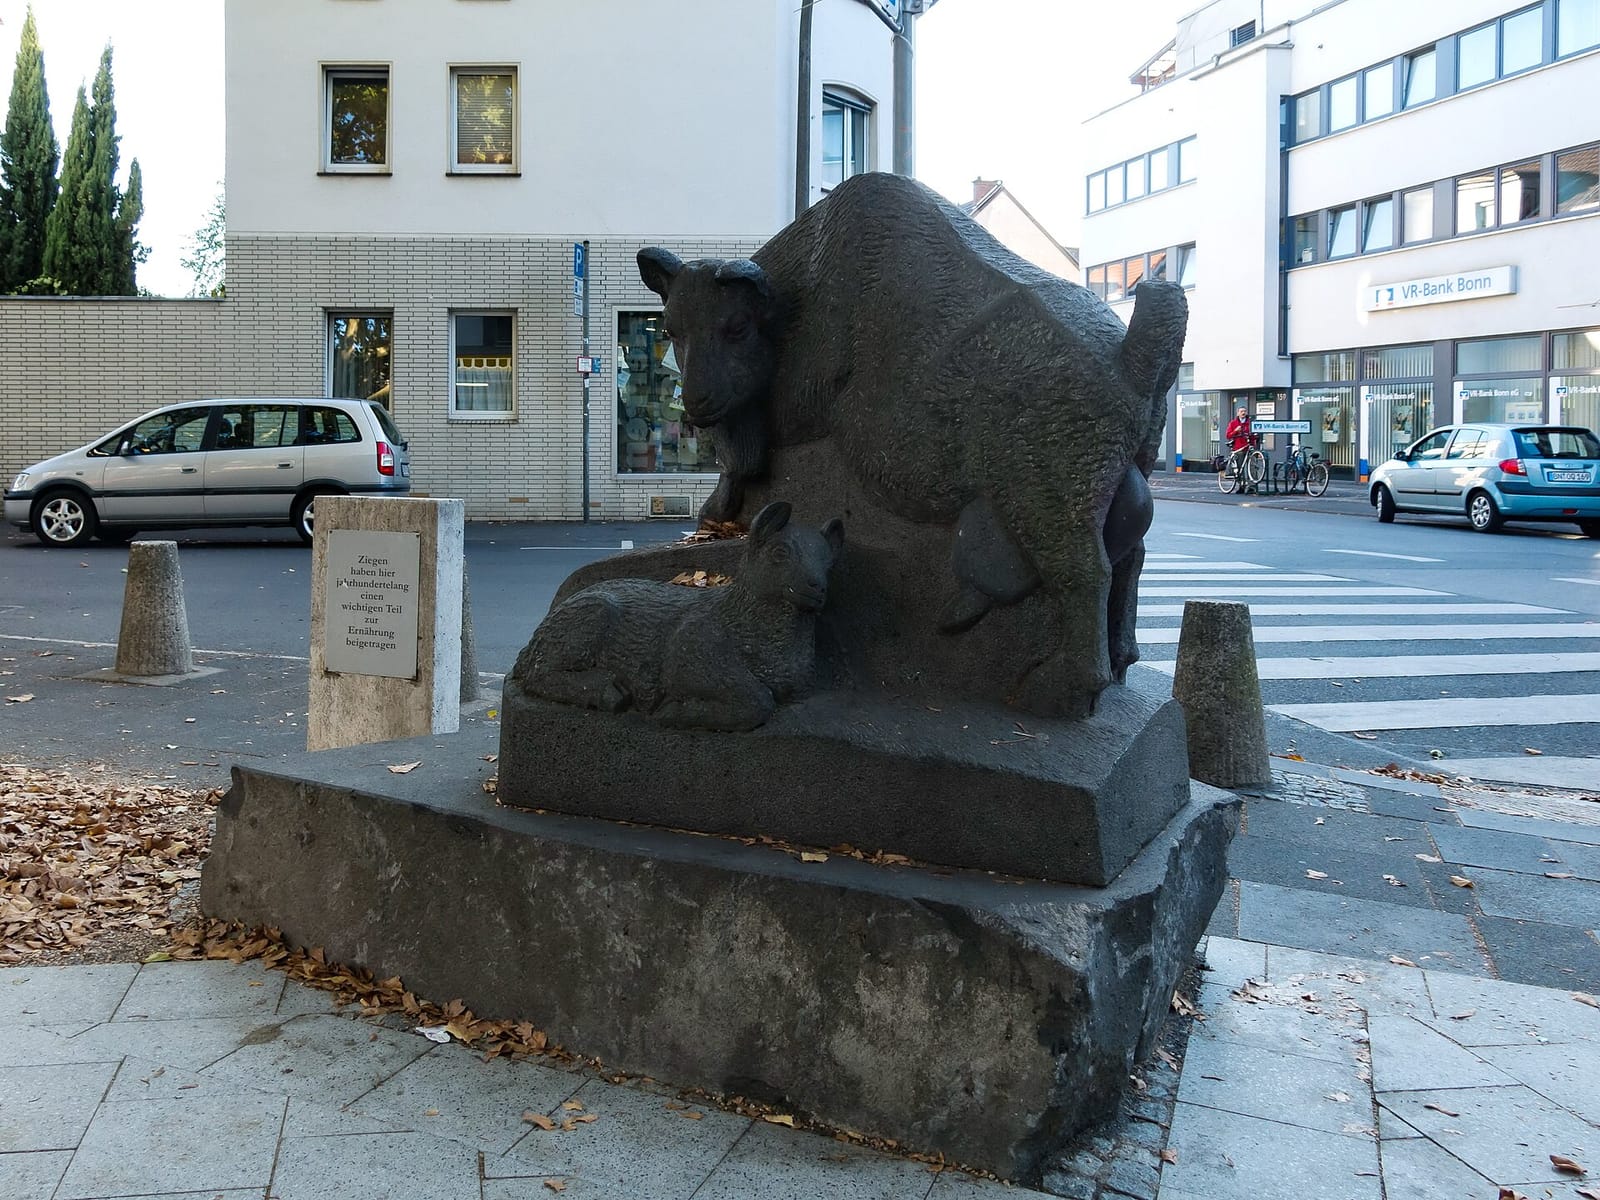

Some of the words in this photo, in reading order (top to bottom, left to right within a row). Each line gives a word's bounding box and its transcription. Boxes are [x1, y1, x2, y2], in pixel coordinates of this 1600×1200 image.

[576, 248, 582, 272] P
[1402, 280, 1453, 299] VR-Bank
[1457, 276, 1492, 292] Bonn
[358, 555, 388, 567] Ziegen
[350, 567, 376, 577] haben
[378, 568, 396, 578] hier
[360, 592, 384, 601] einen
[341, 602, 383, 614] wichtigen
[386, 605, 402, 614] Teil
[364, 616, 379, 625] zur
[348, 626, 395, 640] Ernährung
[346, 638, 396, 651] beigetragen
